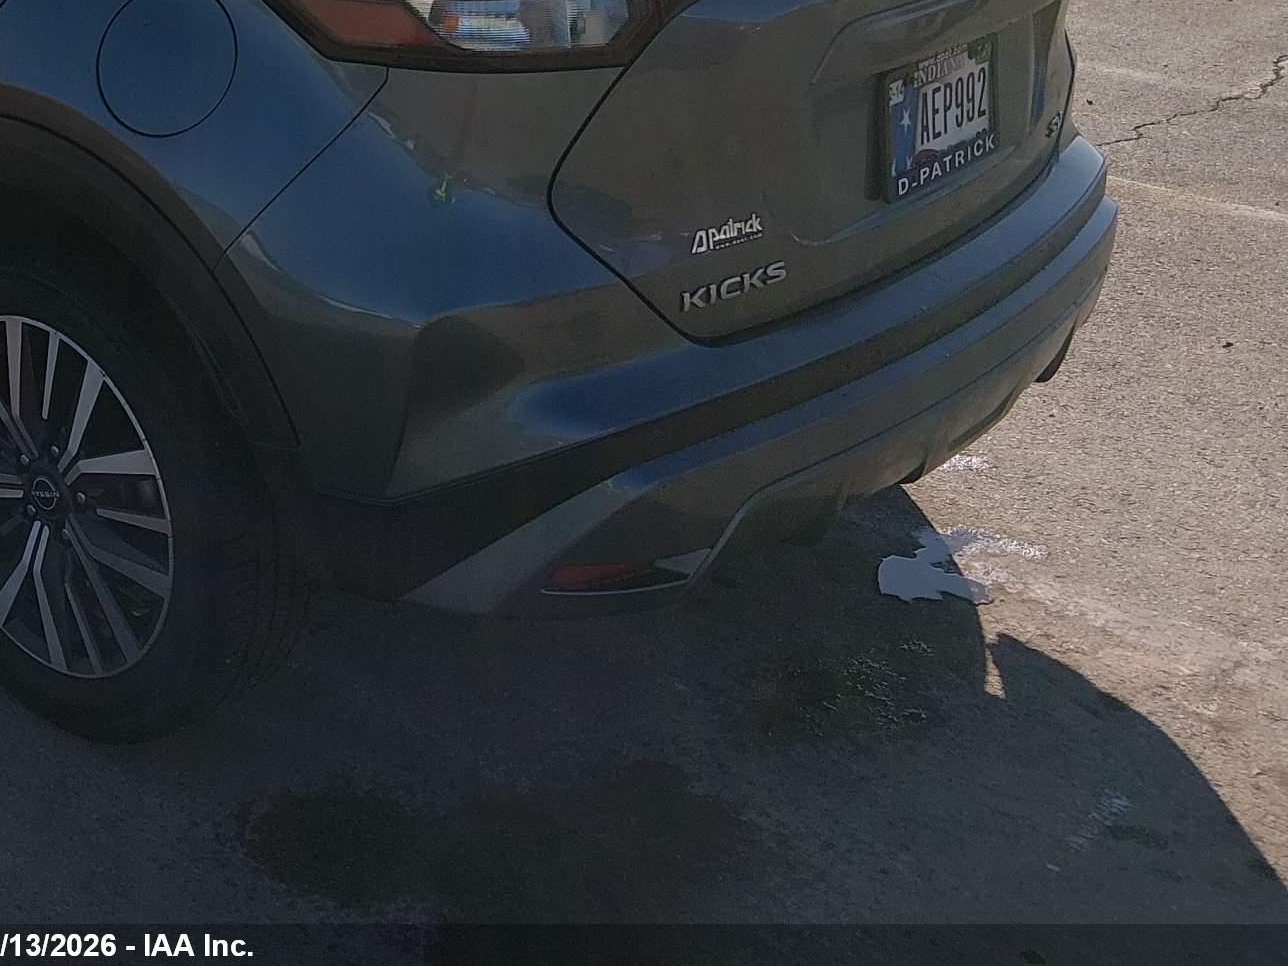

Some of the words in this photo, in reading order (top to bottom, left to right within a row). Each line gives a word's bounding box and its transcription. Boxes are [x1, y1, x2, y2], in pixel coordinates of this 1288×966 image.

[920, 67, 987, 146] AEP992
[897, 134, 996, 196] D-PATRICK
[680, 260, 786, 312] KICKS
